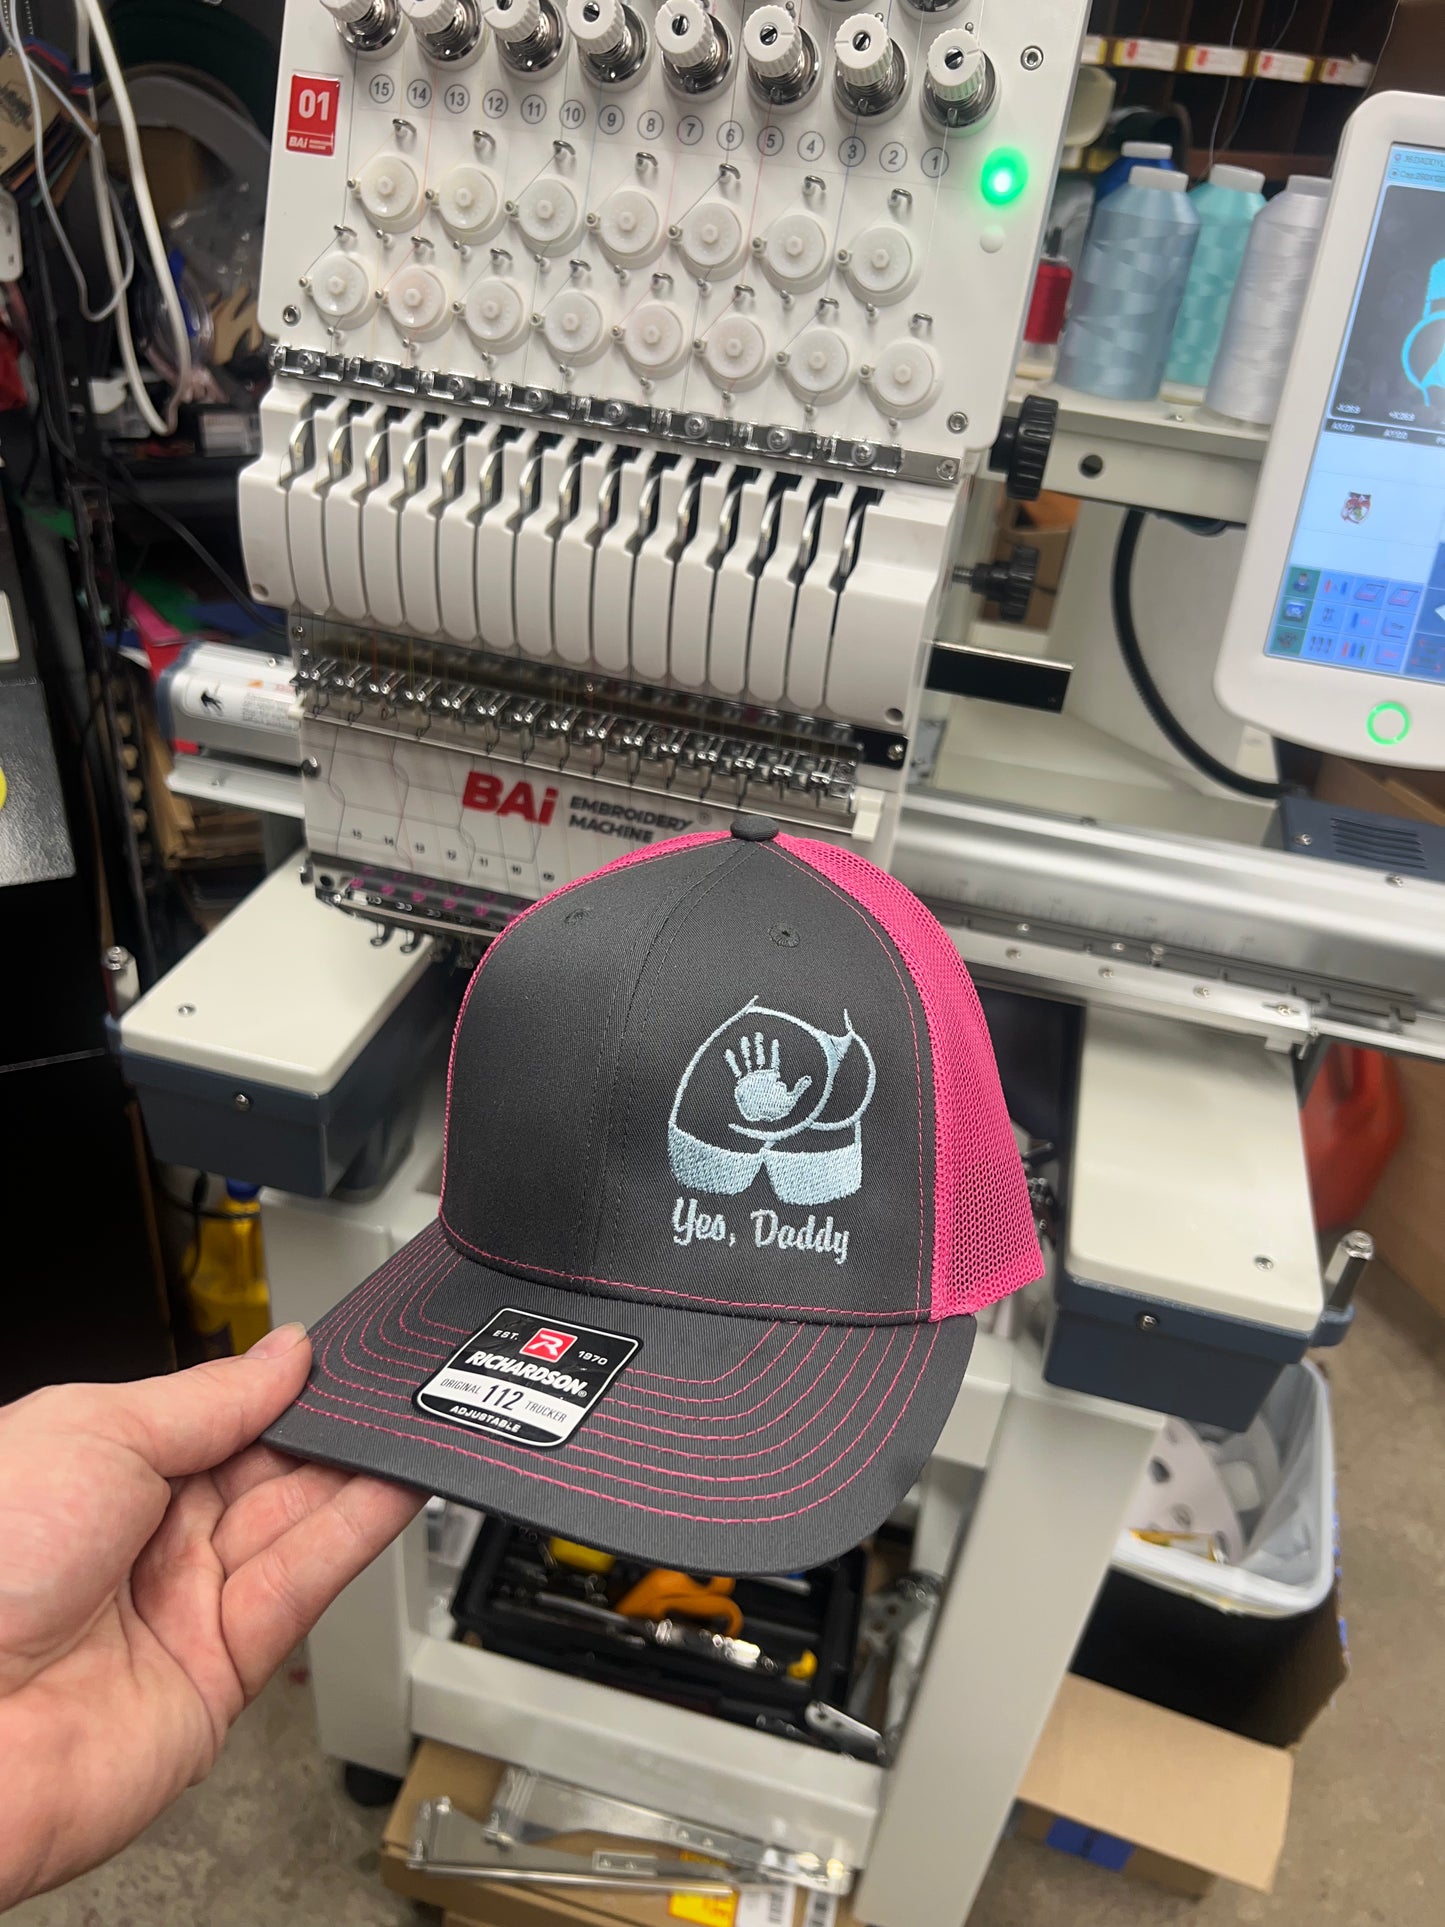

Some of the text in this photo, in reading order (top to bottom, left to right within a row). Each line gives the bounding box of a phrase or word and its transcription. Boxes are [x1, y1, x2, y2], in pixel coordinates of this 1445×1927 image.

[298, 88, 330, 121] 01
[374, 81, 390, 97] 15
[411, 86, 427, 101] 14
[449, 91, 465, 107] 13
[488, 96, 503, 112] 12
[527, 102, 541, 117] 11
[565, 107, 581, 122] 10
[462, 770, 559, 826] BAi
[569, 795, 694, 833] EMBROIDERY
[568, 814, 655, 844] MACHINE
[671, 1196, 850, 1265] Yes, Daddy
[492, 1329, 609, 1366] EST. 1970
[440, 1378, 567, 1423] ORIGINAL 112 TRUCKER
[449, 1405, 522, 1434] ADJUSTABLE
